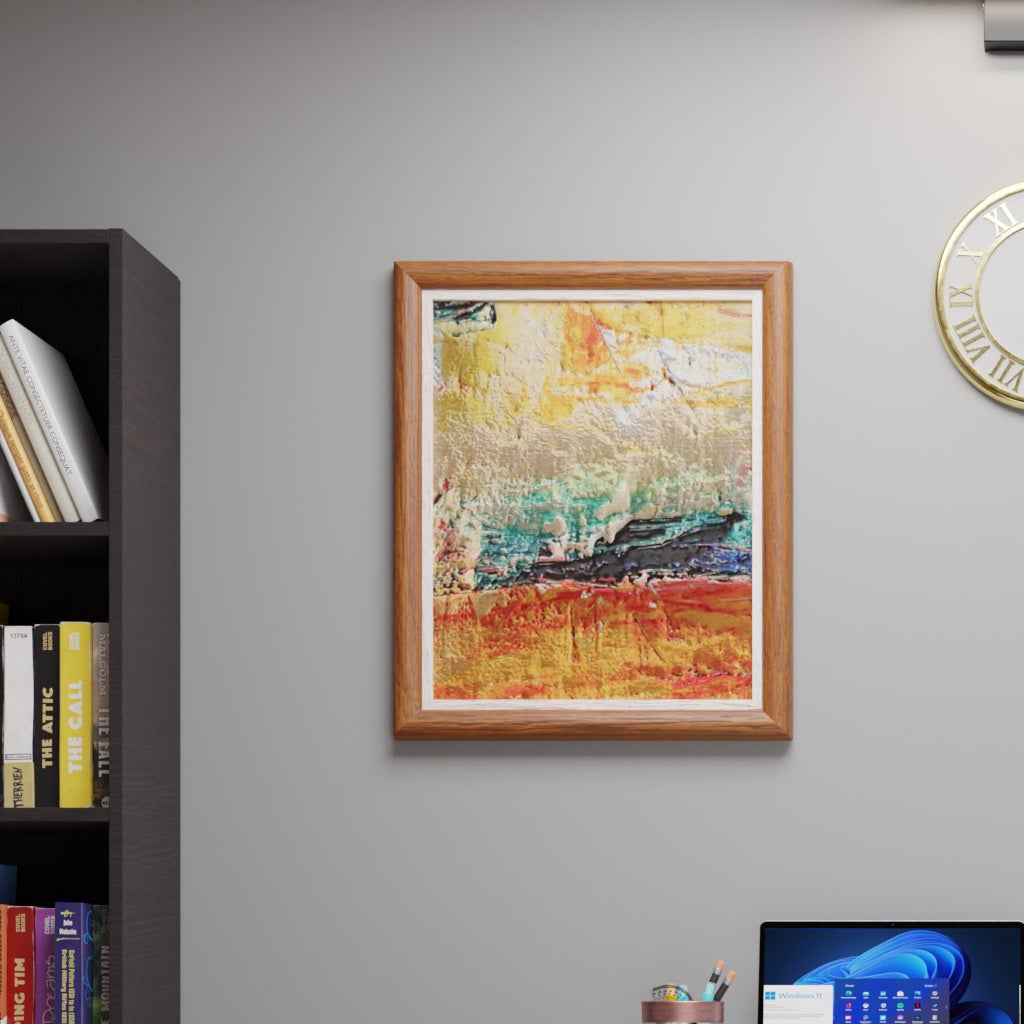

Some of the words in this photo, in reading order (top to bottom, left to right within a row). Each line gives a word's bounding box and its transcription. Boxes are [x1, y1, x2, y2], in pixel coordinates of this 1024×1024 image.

[983, 201, 1019, 237] XI
[956, 241, 984, 267] X
[949, 283, 973, 307] IX
[953, 316, 990, 363] VIII
[988, 356, 1024, 393] VII
[42, 687, 54, 734] ATTIC
[68, 680, 83, 730] CALL
[42, 738, 53, 769] THE
[68, 737, 83, 774] THE
[14, 957, 25, 987] TIM
